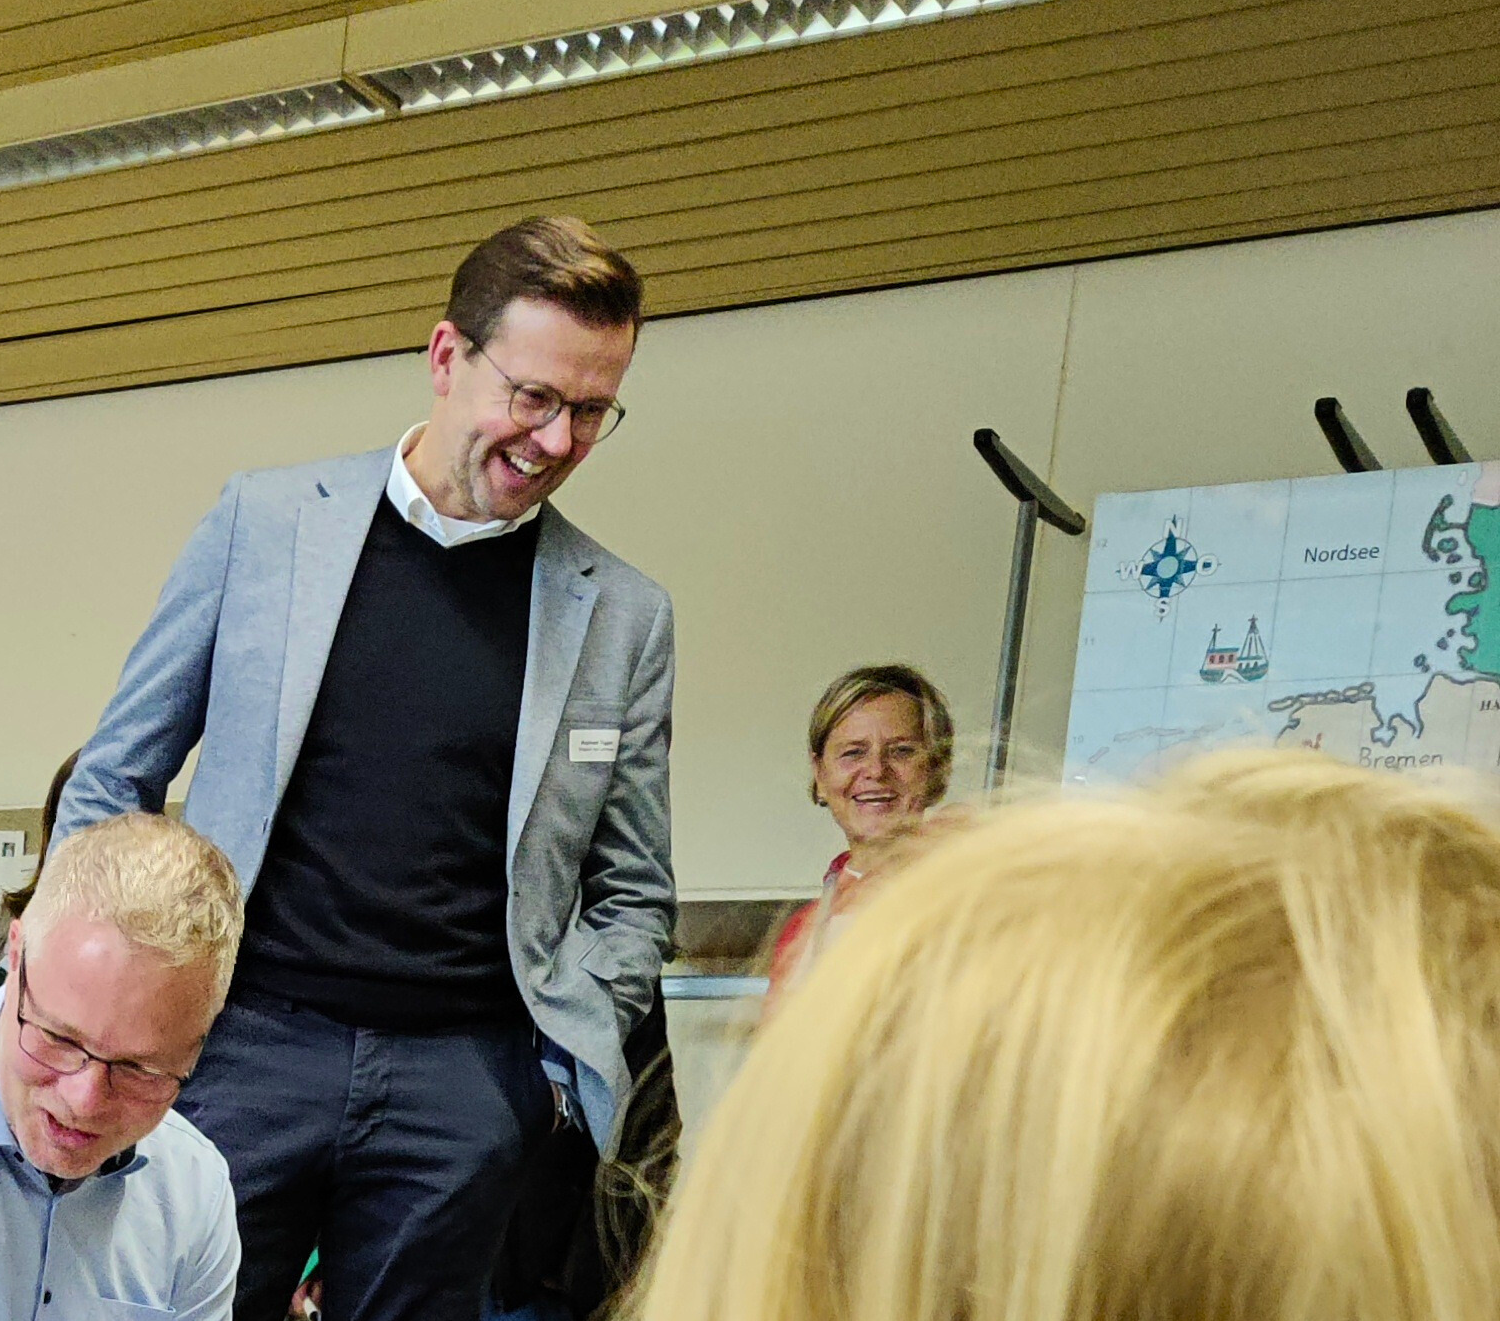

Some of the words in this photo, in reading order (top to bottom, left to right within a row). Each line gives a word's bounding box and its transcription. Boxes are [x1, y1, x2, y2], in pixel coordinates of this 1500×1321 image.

[1162, 518, 1185, 539] N
[1304, 543, 1380, 563] Nordsee
[1119, 560, 1146, 581] W
[1196, 553, 1219, 577] O
[1359, 746, 1443, 769] Bremen
